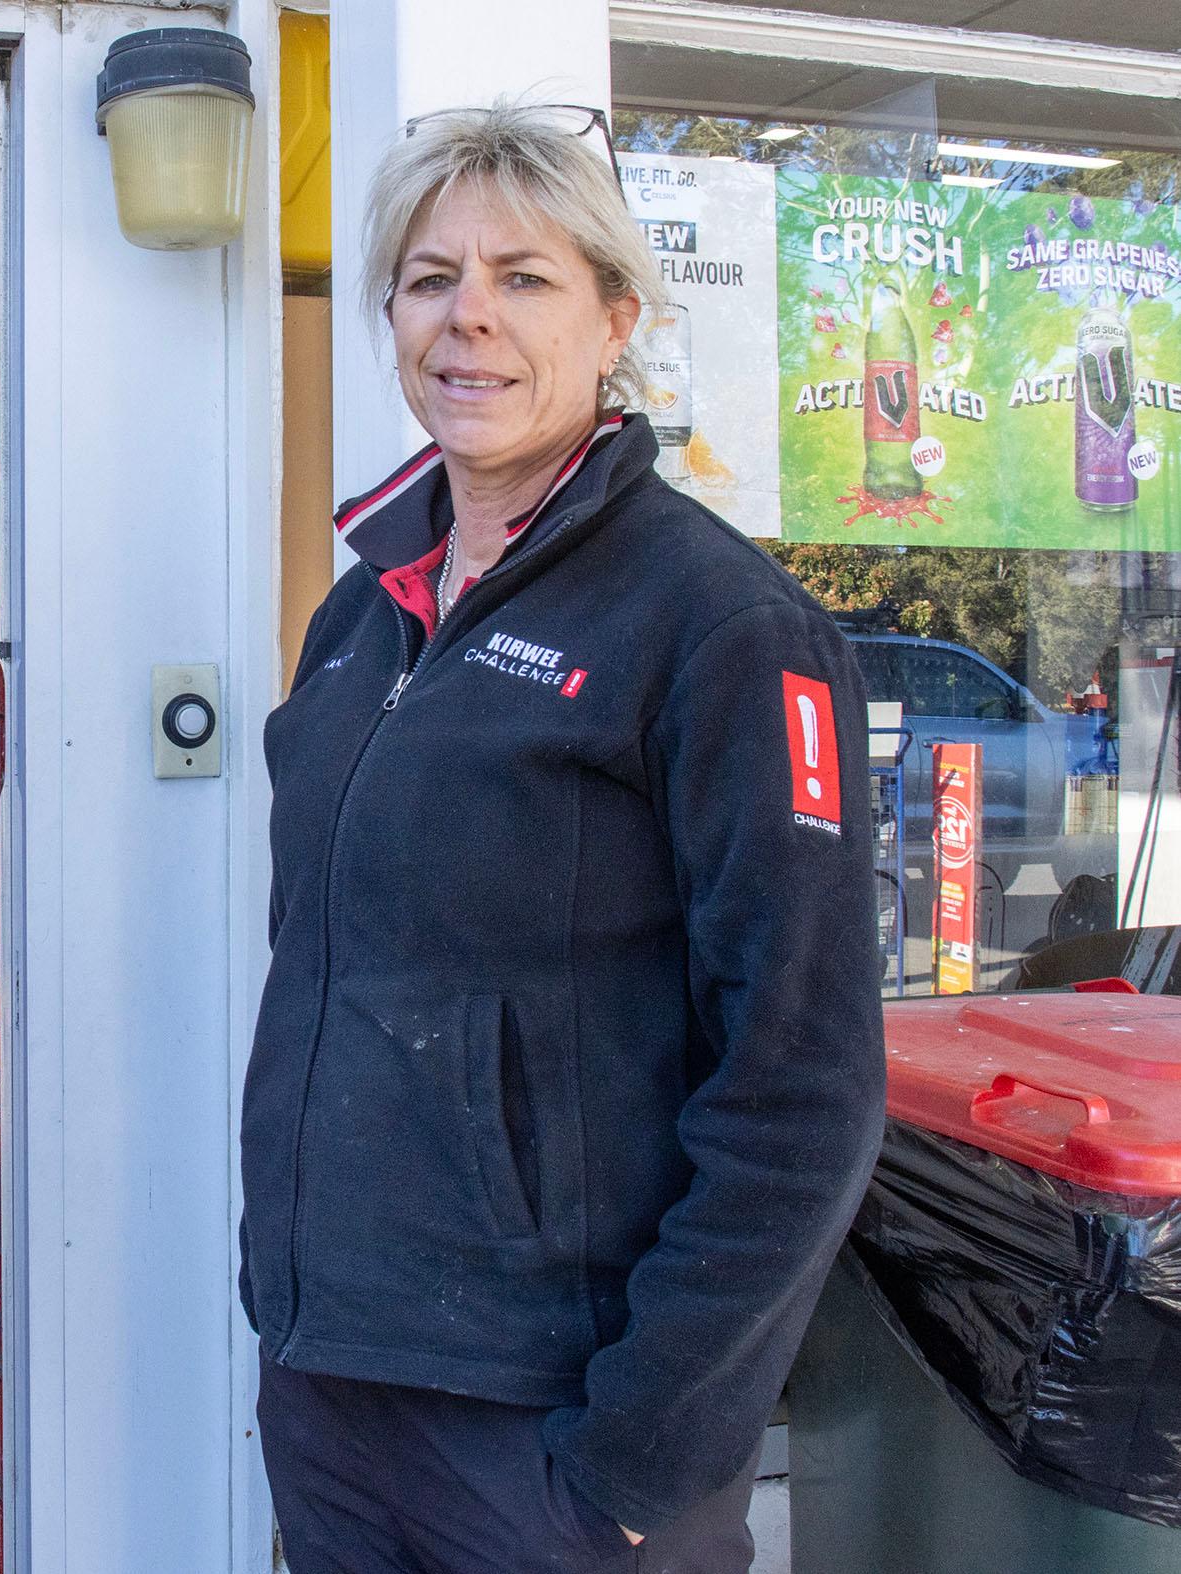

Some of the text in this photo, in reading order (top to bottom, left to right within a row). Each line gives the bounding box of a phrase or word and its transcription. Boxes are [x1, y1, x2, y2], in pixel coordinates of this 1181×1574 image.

[618, 166, 697, 187] LIVE. FIT. GO.
[825, 197, 947, 229] YOUR NEW
[812, 223, 963, 276] CRUSH
[1006, 239, 1181, 278] SAME GRAPENES
[661, 258, 743, 287] FLAVOUR
[1036, 265, 1165, 297] ZERO SUGAR
[912, 445, 943, 467] NEW
[1129, 450, 1156, 472] NEW
[487, 632, 564, 668] KIRWEE
[794, 812, 842, 837] CHALLENGE
